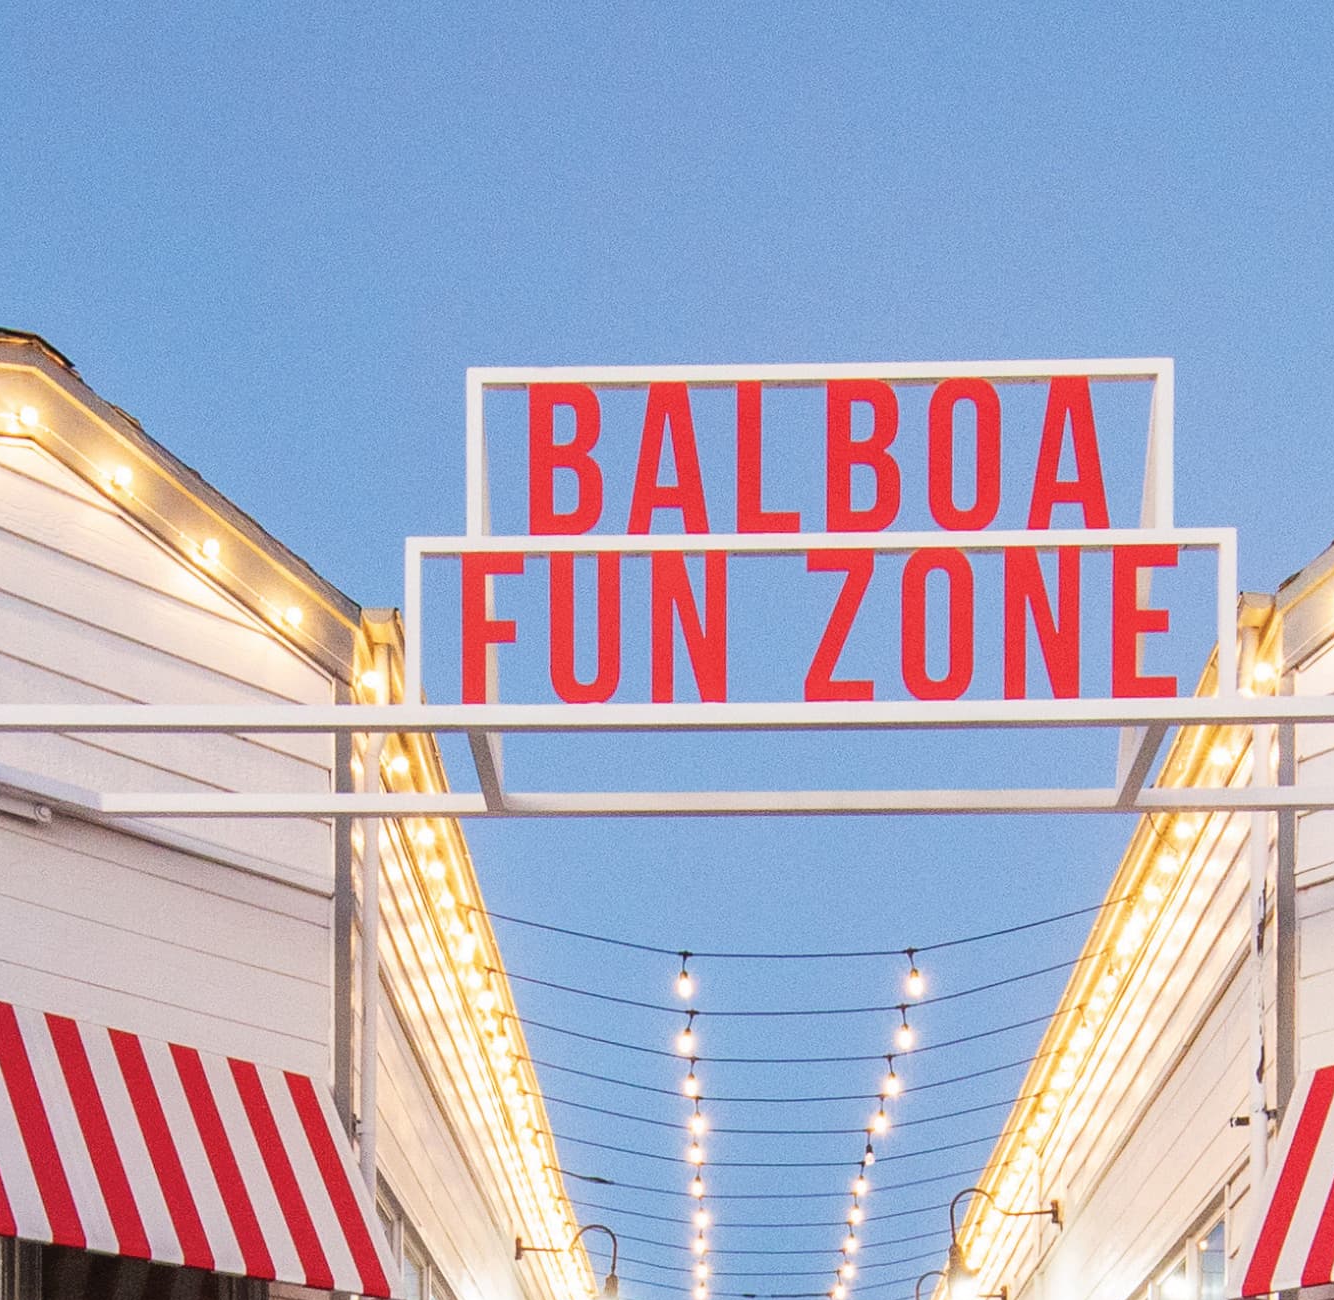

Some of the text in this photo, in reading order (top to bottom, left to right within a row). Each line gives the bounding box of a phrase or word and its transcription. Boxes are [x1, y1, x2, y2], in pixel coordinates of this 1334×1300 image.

[528, 376, 1110, 535] BALBOA
[461, 544, 1179, 704] FUN ZONE
